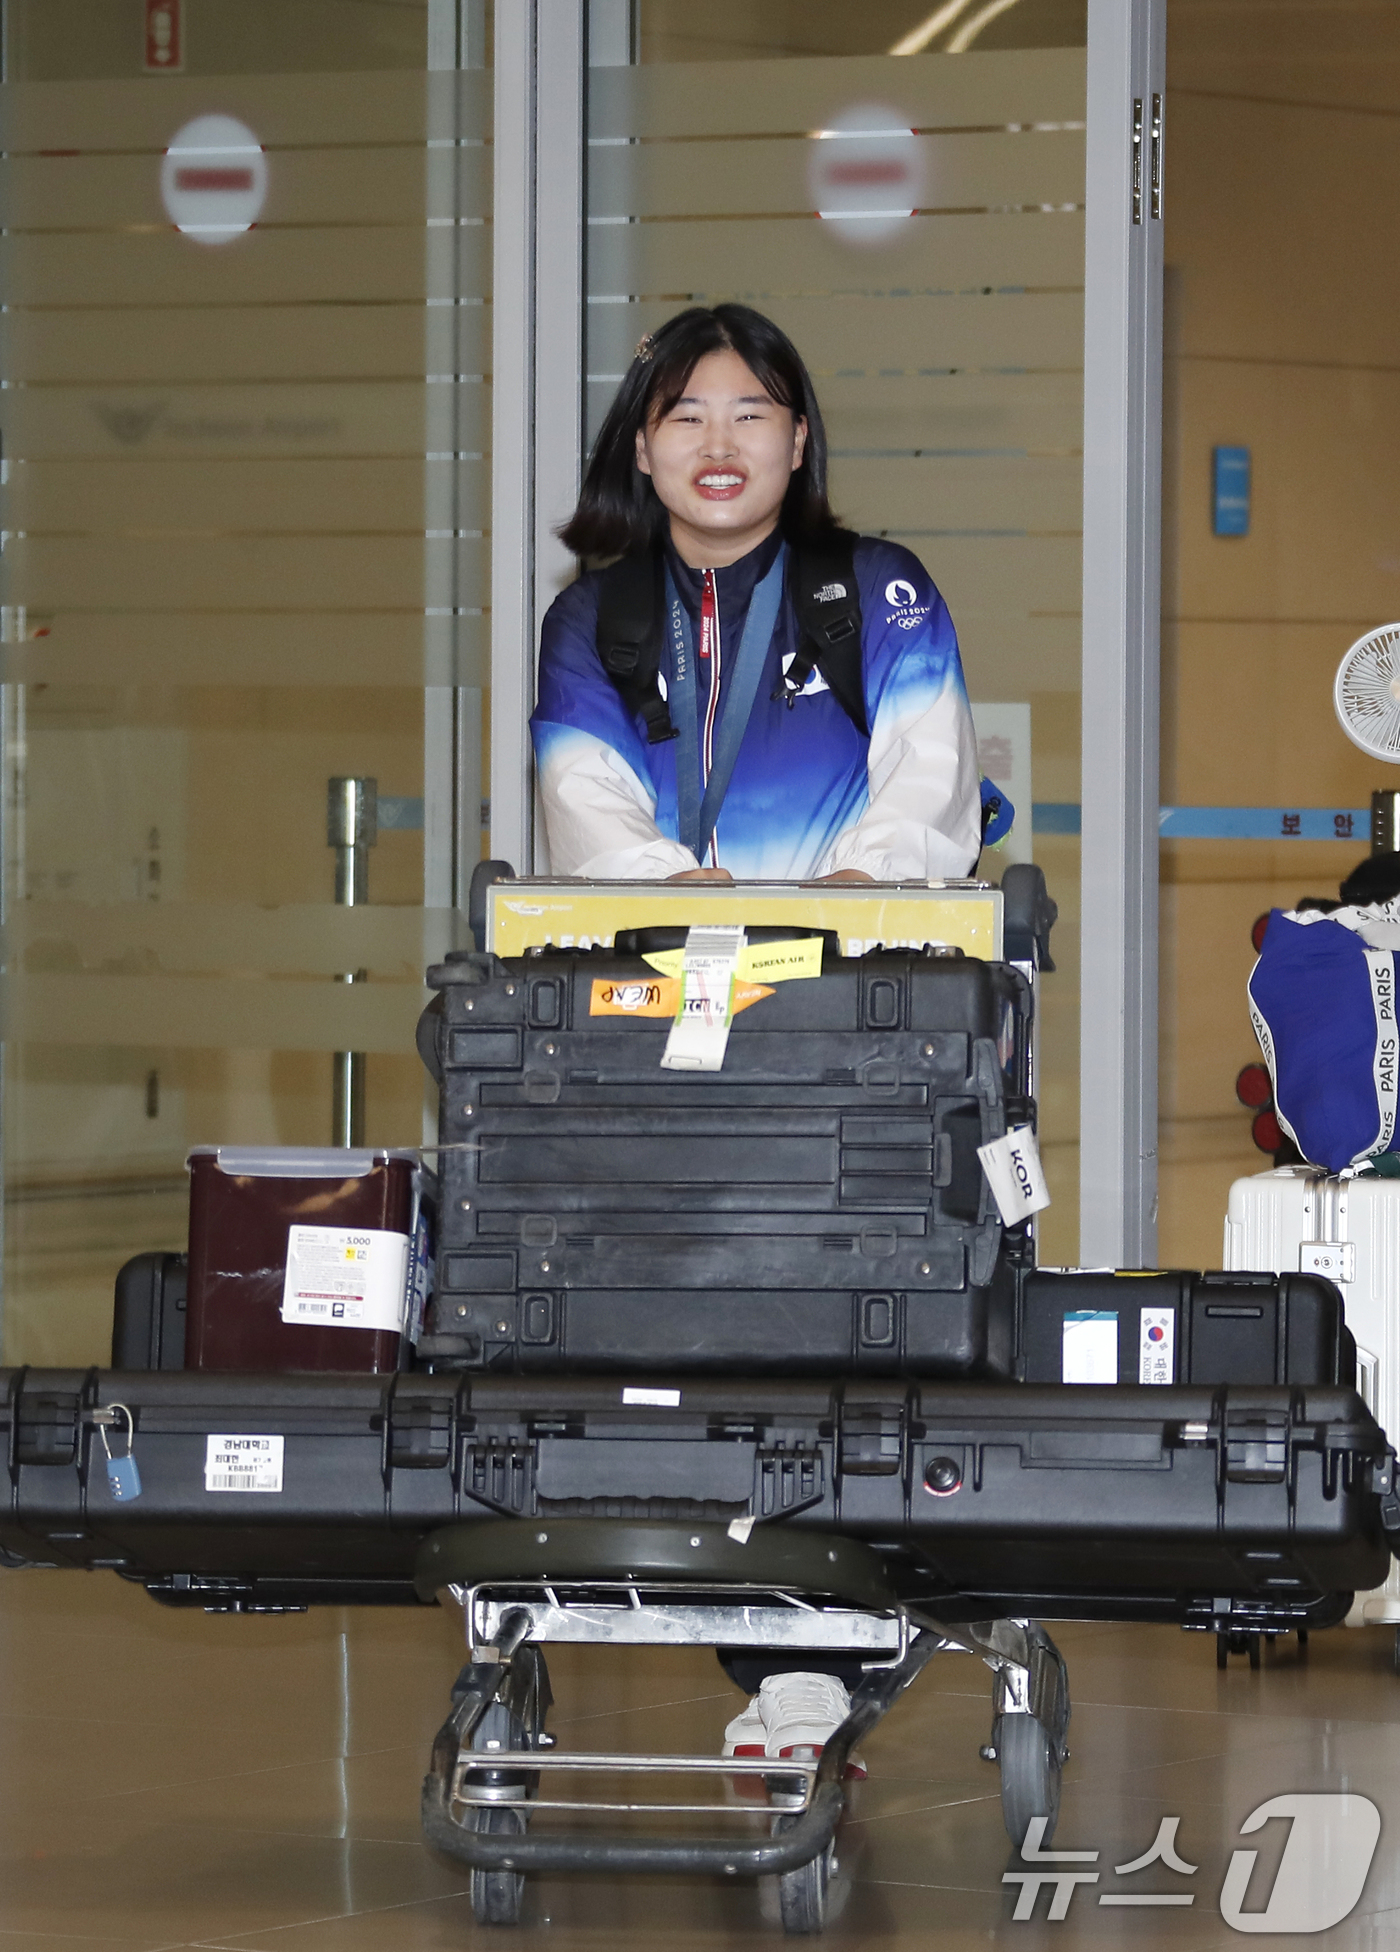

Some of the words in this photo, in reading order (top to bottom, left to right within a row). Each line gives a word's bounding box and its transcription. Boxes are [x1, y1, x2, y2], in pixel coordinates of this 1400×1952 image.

[672, 600, 683, 639] 2024
[886, 608, 908, 624] PARIS
[676, 641, 687, 681] PARIS
[752, 958, 786, 969] KOREAN
[788, 956, 805, 965] AIR
[1376, 967, 1391, 1020] PARIS
[1252, 1012, 1272, 1064] PARIS
[1379, 1038, 1395, 1092] PARIS
[1366, 1111, 1393, 1158] PARIS
[1011, 1149, 1033, 1199] KOR
[1143, 1357, 1152, 1384] KORE
